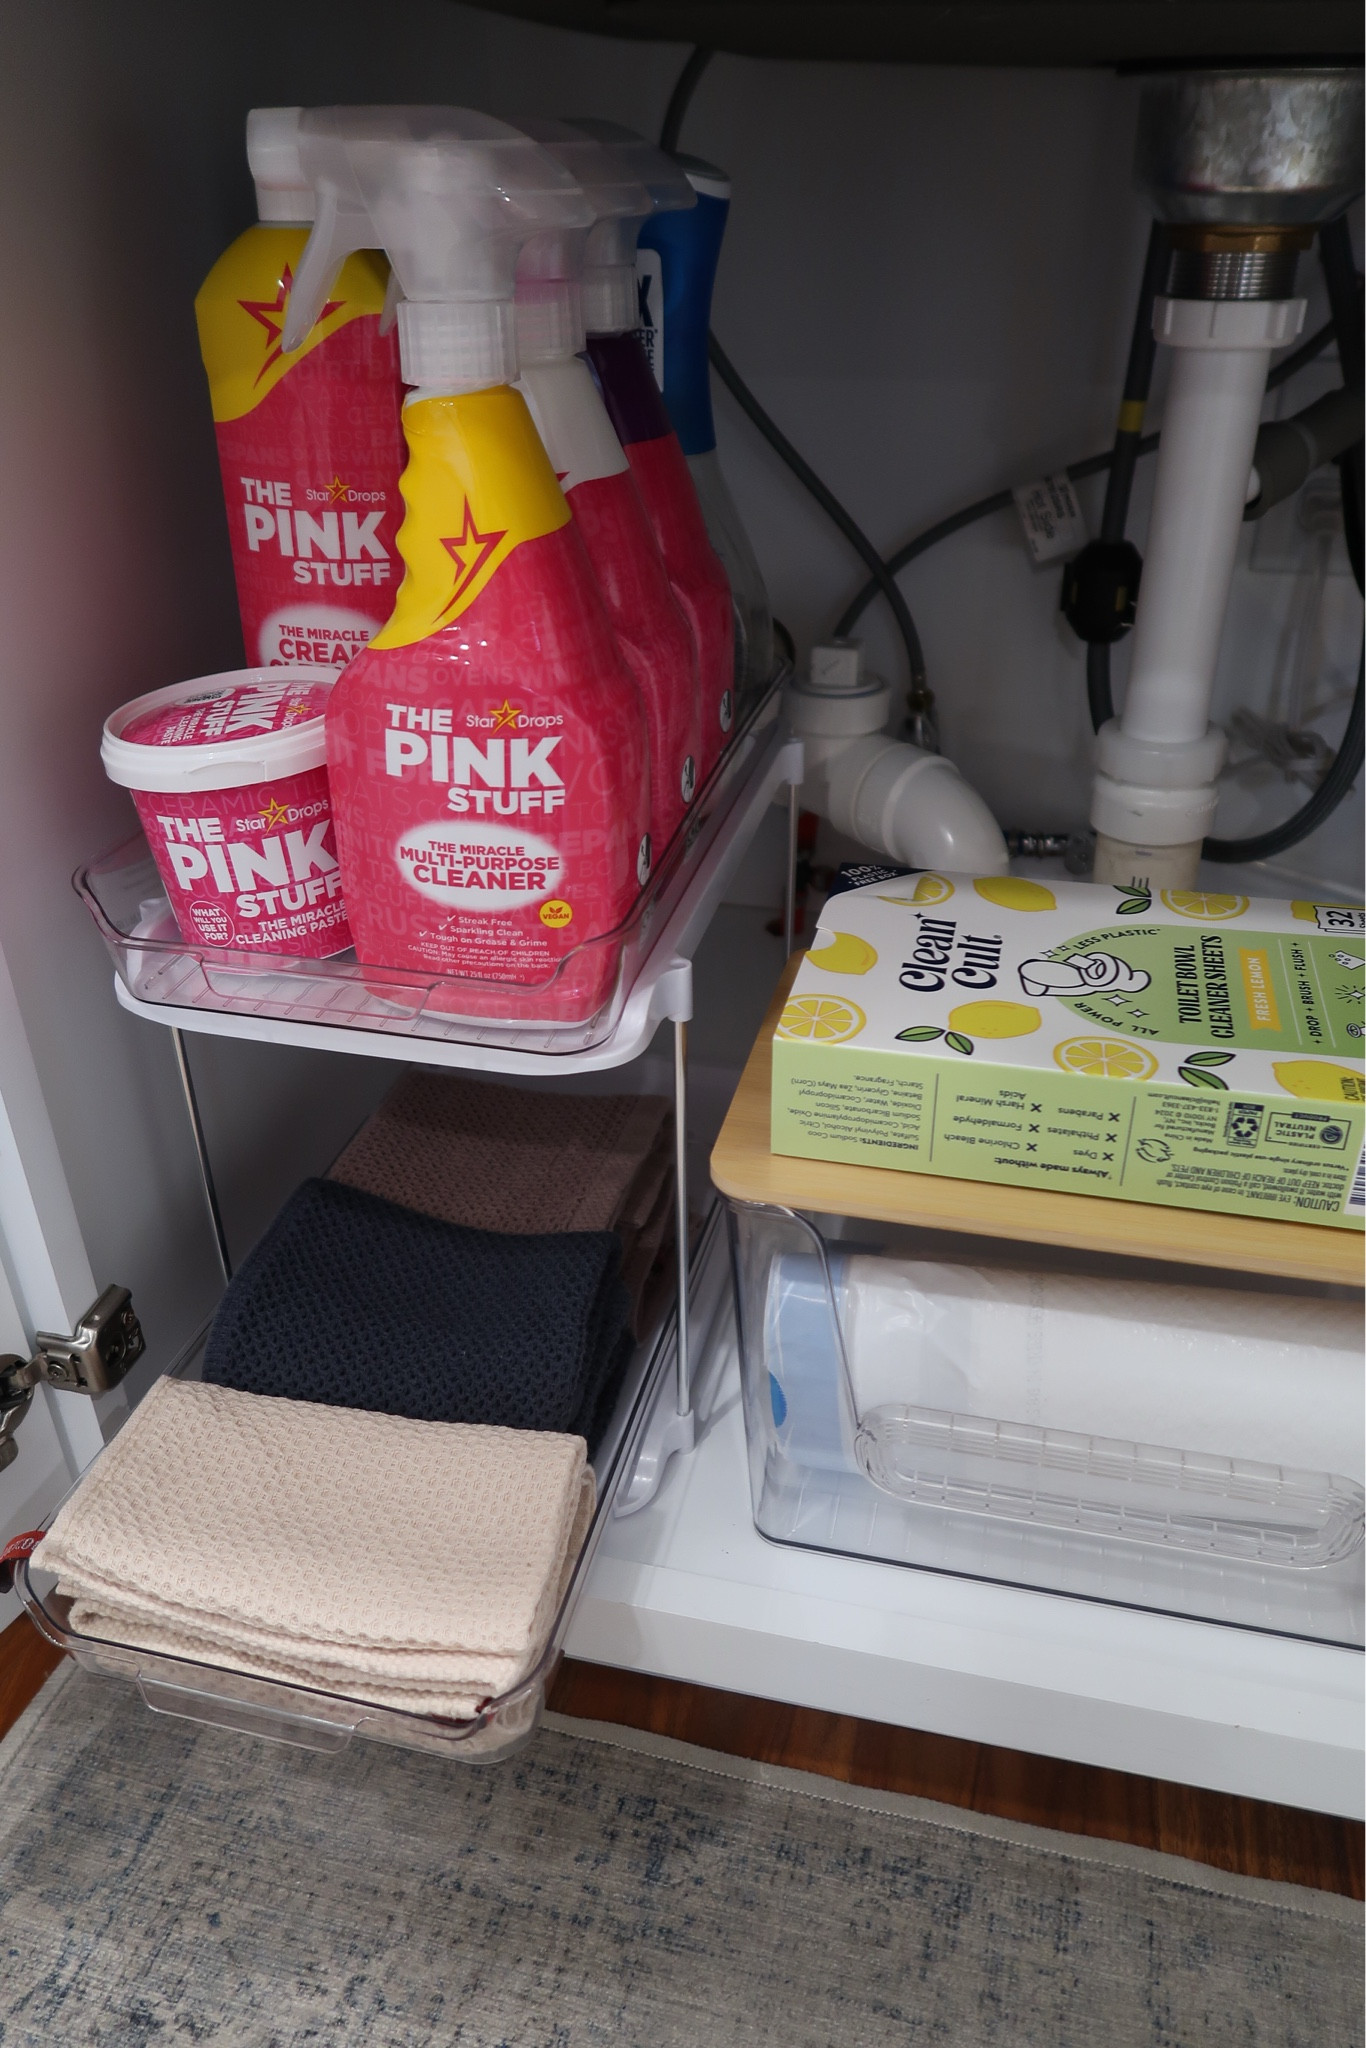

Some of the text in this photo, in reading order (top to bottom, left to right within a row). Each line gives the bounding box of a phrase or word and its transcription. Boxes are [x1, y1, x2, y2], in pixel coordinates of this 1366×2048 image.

[240, 476, 292, 506] THE
[306, 489, 386, 503] Star Drops
[244, 503, 391, 560] PINK
[293, 560, 390, 586] STUFF
[279, 624, 369, 641] THE MIRACLE
[223, 683, 292, 733] PINK
[200, 700, 235, 736] STUFF
[386, 702, 452, 733] THE
[466, 714, 563, 729] Star Drops
[385, 728, 565, 788] PINK
[447, 787, 565, 815] STUFF
[236, 800, 329, 832] Star Drops
[156, 815, 225, 843] THE
[165, 819, 339, 893] PINK
[429, 840, 525, 856] THE MIRACLE
[400, 846, 559, 871] MULTI-PURPOSE
[413, 864, 546, 890] CLEANER
[841, 865, 881, 876] 100%
[851, 870, 888, 881] PLASTIC
[236, 870, 342, 918] STUFF
[258, 900, 345, 931] THE MIRACLE
[458, 916, 512, 926] Streak Free
[1326, 911, 1354, 926] 32
[235, 910, 348, 944] CLEANING PASTE
[450, 926, 523, 937] Sparkling Clean
[430, 932, 458, 943] Tough
[475, 937, 507, 946] Grease
[519, 939, 547, 947] Grime
[1073, 937, 1101, 950] LESS
[470, 947, 495, 955] REACH
[899, 918, 957, 992] Clean
[1174, 945, 1202, 1023] TOILET BOWL
[1200, 936, 1235, 1038] CLEANER SHEETS
[1248, 957, 1271, 1021] FRESH LEMON
[1291, 949, 1322, 1037] DROP BRUSH FLUSH
[1074, 1002, 1159, 1035] ALL POWER
[791, 1078, 816, 1086] (Corn)
[818, 1081, 837, 1089] Mays
[799, 1090, 861, 1103] Cocamidopropyl
[956, 1095, 1024, 1110] Harsh Mineral
[1000, 1090, 1026, 1100] Acids
[787, 1108, 812, 1117] Oxide,
[816, 1103, 920, 1121] Sodium Bicarbonate, Silicon
[1058, 1108, 1103, 1120] Parabens
[800, 1120, 919, 1141] Sulfate, Polyvinyl Alcohol, Citric
[953, 1116, 1022, 1131] Formaldehyde
[1274, 1122, 1316, 1131] NEUTRAL
[808, 1131, 918, 1150] INGREDIENTS: Sodium Coco
[1048, 1127, 1099, 1140] Phthalates
[1276, 1130, 1314, 1139] PLASTIC
[944, 1134, 1020, 1150] Chlorine Bleach
[1074, 1150, 1097, 1159] Dyes
[1041, 1163, 1069, 1171] made
[1277, 1177, 1286, 1185] OF
[1287, 1178, 1301, 1186] OUT
[1302, 1180, 1319, 1189] KEEP
[1294, 1196, 1340, 1212] CAUTION:
